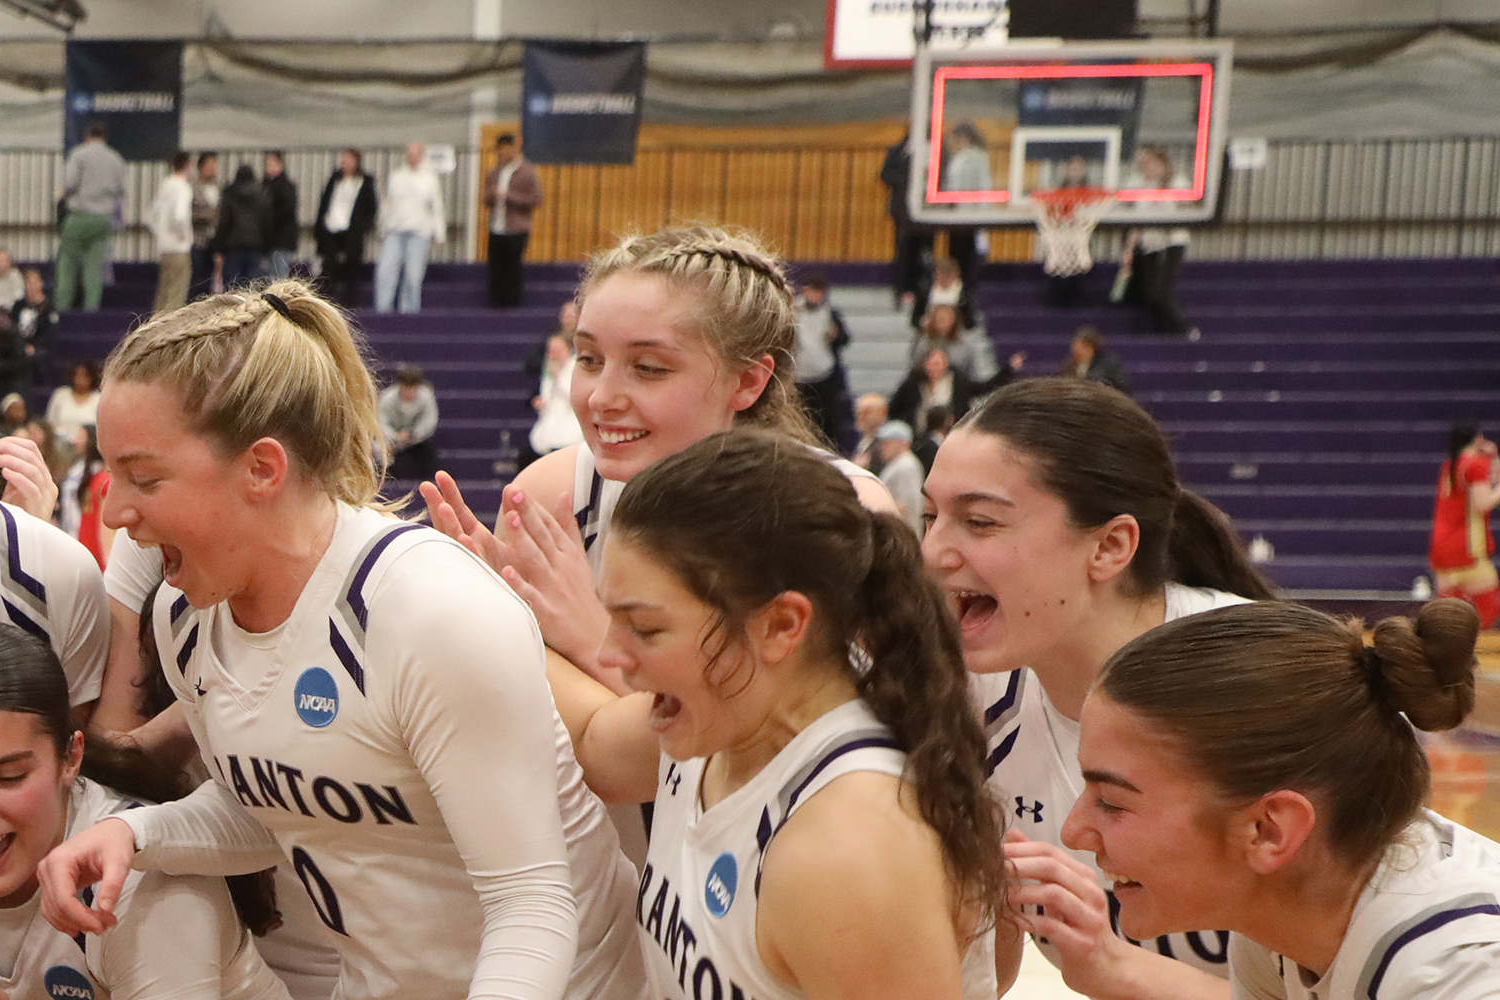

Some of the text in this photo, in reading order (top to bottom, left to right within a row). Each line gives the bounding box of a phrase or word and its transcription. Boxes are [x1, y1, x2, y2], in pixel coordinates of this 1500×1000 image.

[300, 693, 336, 715] NCAA
[214, 754, 420, 826] ANTON
[52, 983, 92, 1000] NCAA
